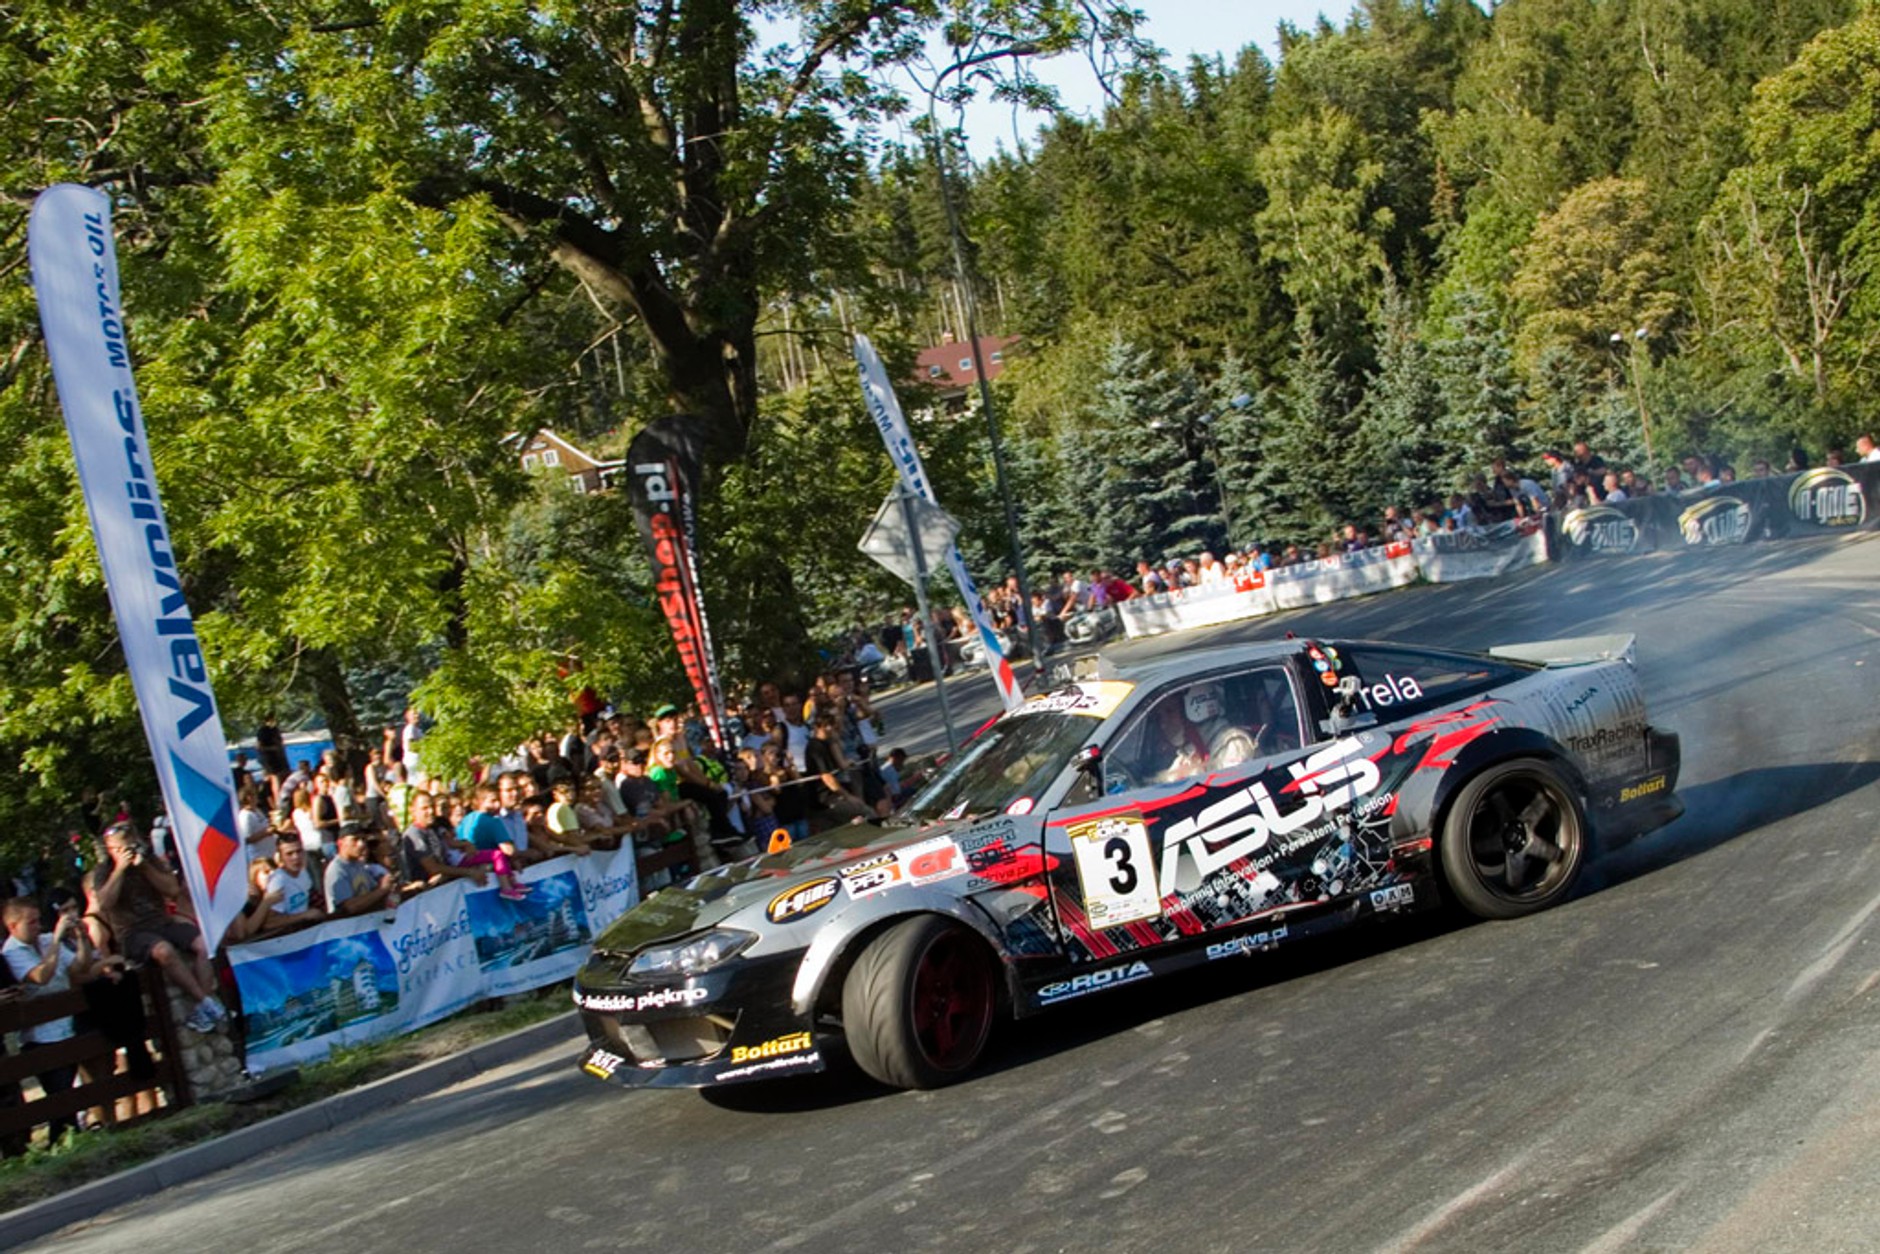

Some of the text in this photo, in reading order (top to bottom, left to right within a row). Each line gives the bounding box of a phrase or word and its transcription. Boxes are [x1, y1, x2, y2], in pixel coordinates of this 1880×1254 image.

[84, 212, 105, 257] OIL
[113, 390, 214, 740] Valvoline
[1620, 776, 1665, 801] Bottari
[1160, 736, 1381, 899] ASUS
[1103, 837, 1138, 896] 3
[1072, 959, 1152, 990] ROTA
[732, 1032, 812, 1063] Bottari
